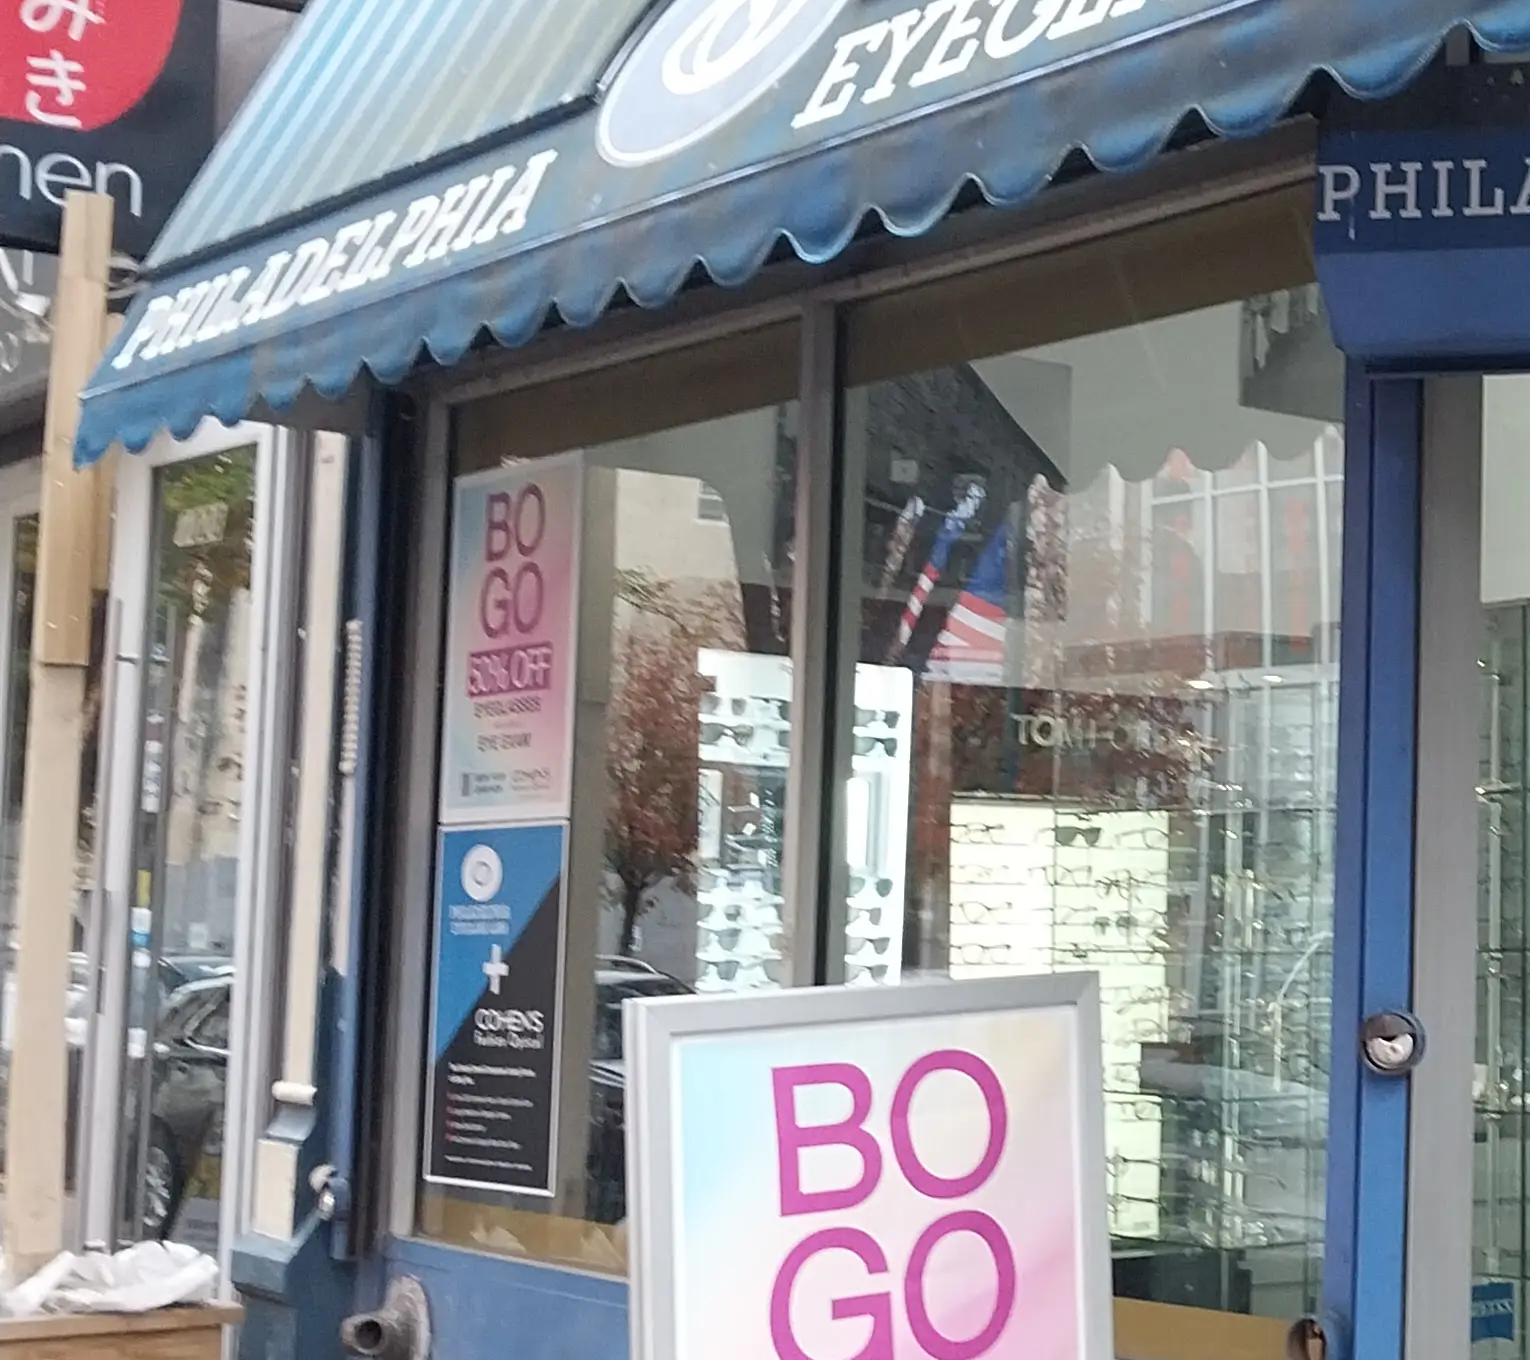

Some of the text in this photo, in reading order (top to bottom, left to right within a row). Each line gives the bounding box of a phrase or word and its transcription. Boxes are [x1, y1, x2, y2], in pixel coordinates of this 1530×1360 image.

[111, 149, 558, 369] PHILADELPHIA
[485, 483, 546, 562] BO
[480, 561, 544, 638] GO
[770, 1049, 1008, 1217] BO
